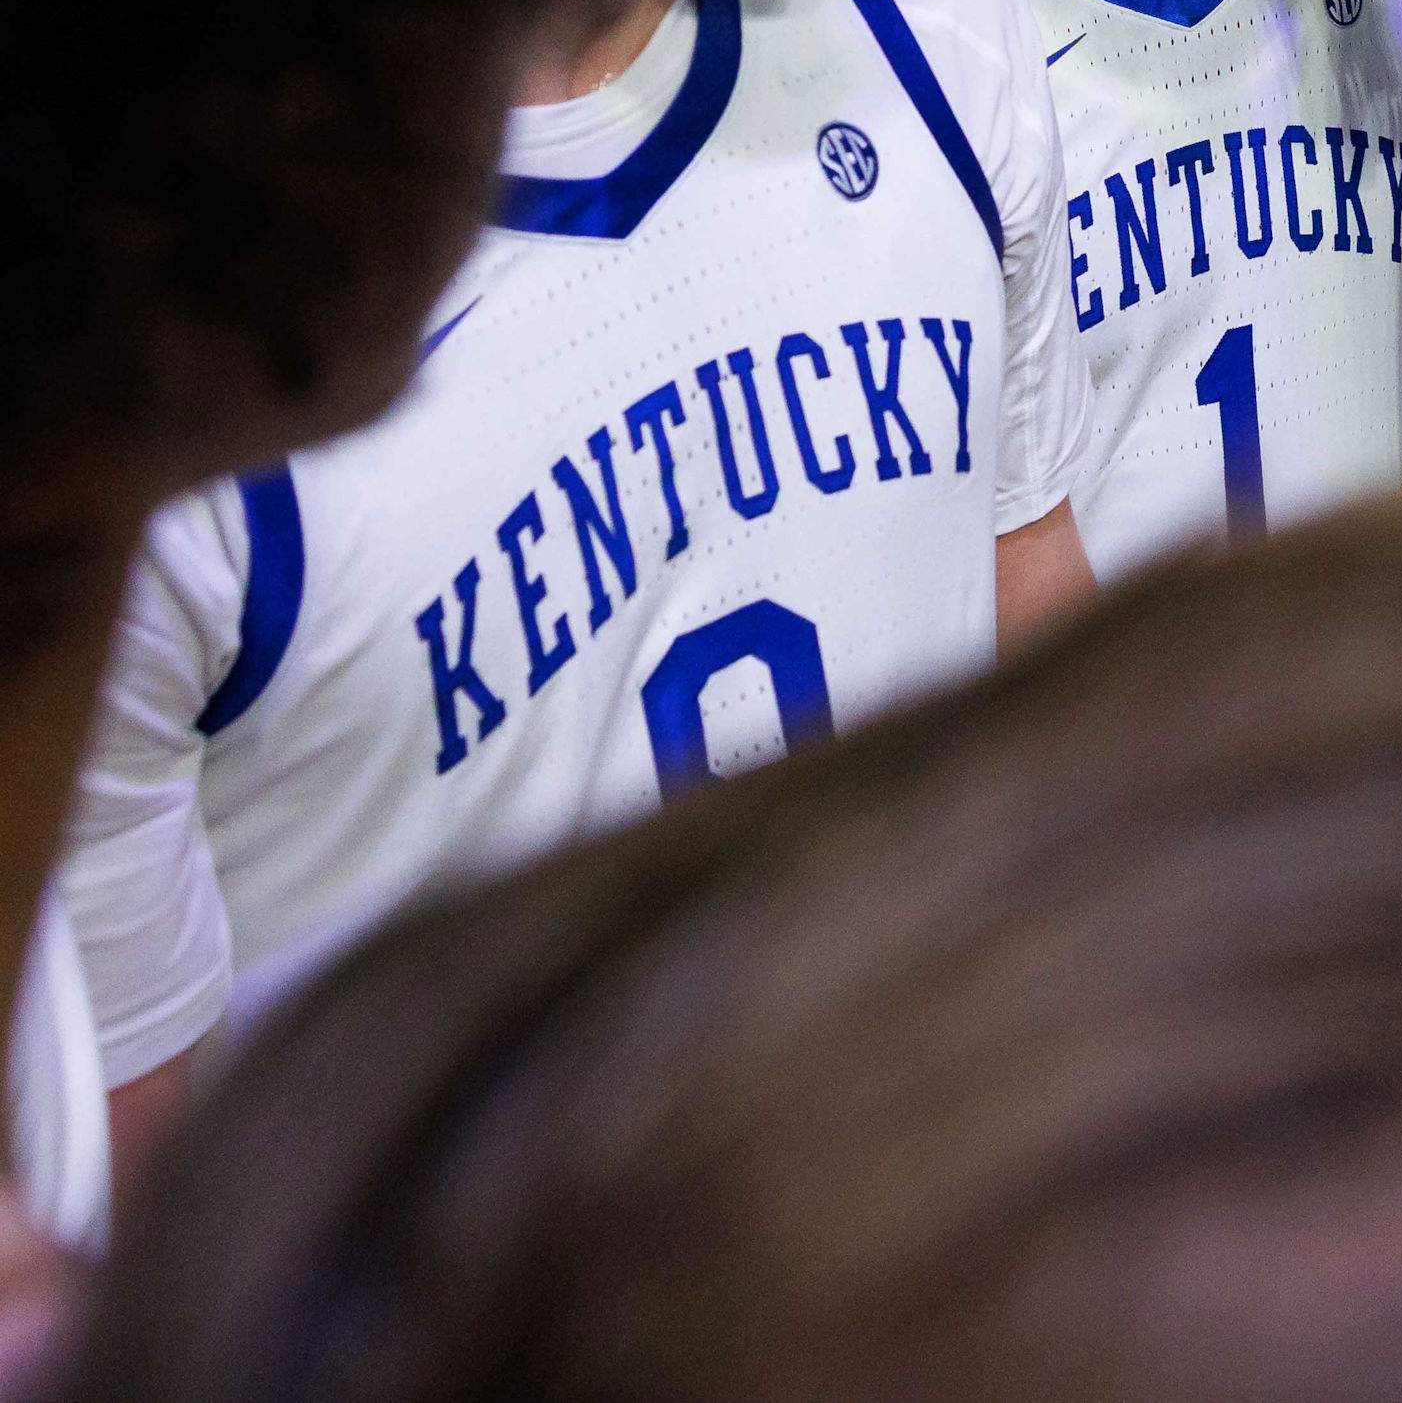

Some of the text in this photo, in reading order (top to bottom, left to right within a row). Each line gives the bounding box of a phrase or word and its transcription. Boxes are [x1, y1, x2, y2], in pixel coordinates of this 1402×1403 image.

[819, 125, 876, 198] SEC
[414, 316, 974, 776] KENTUCKY
[1195, 324, 1267, 553] 1
